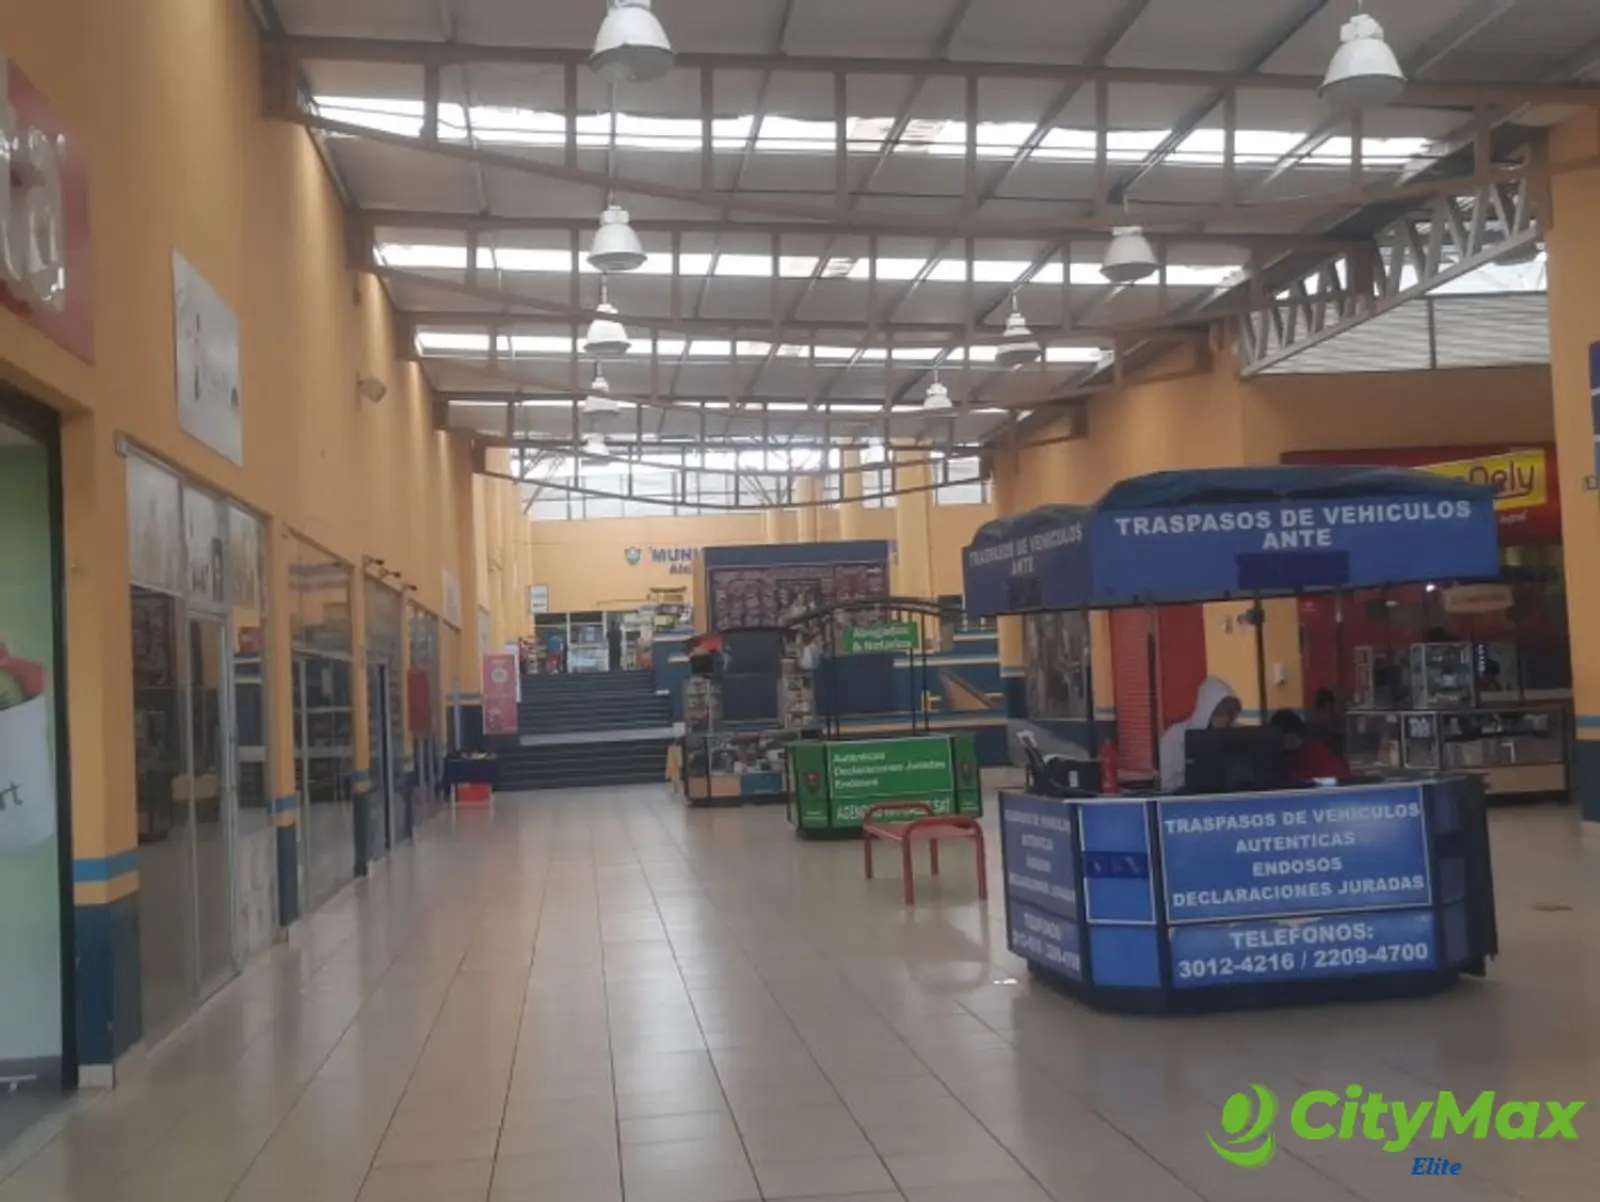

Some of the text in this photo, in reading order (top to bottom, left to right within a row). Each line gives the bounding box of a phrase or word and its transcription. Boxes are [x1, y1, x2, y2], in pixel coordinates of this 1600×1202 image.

[1115, 510, 1271, 536] TRASPASOS
[1281, 508, 1314, 527] DE
[1322, 499, 1472, 526] VEHICULOS
[1262, 528, 1332, 550] ANTE
[1164, 801, 1422, 834] TRASPASOS DE VEHICULOS
[1235, 832, 1356, 854] AUTENTICAS
[1252, 857, 1343, 877] ENDOSOS
[1172, 875, 1425, 907] DECLARACIONES JURADAS
[1229, 922, 1374, 950] TELEFONOS:
[1178, 952, 1295, 979] 3012-4216
[1313, 942, 1429, 969] 2209-4700
